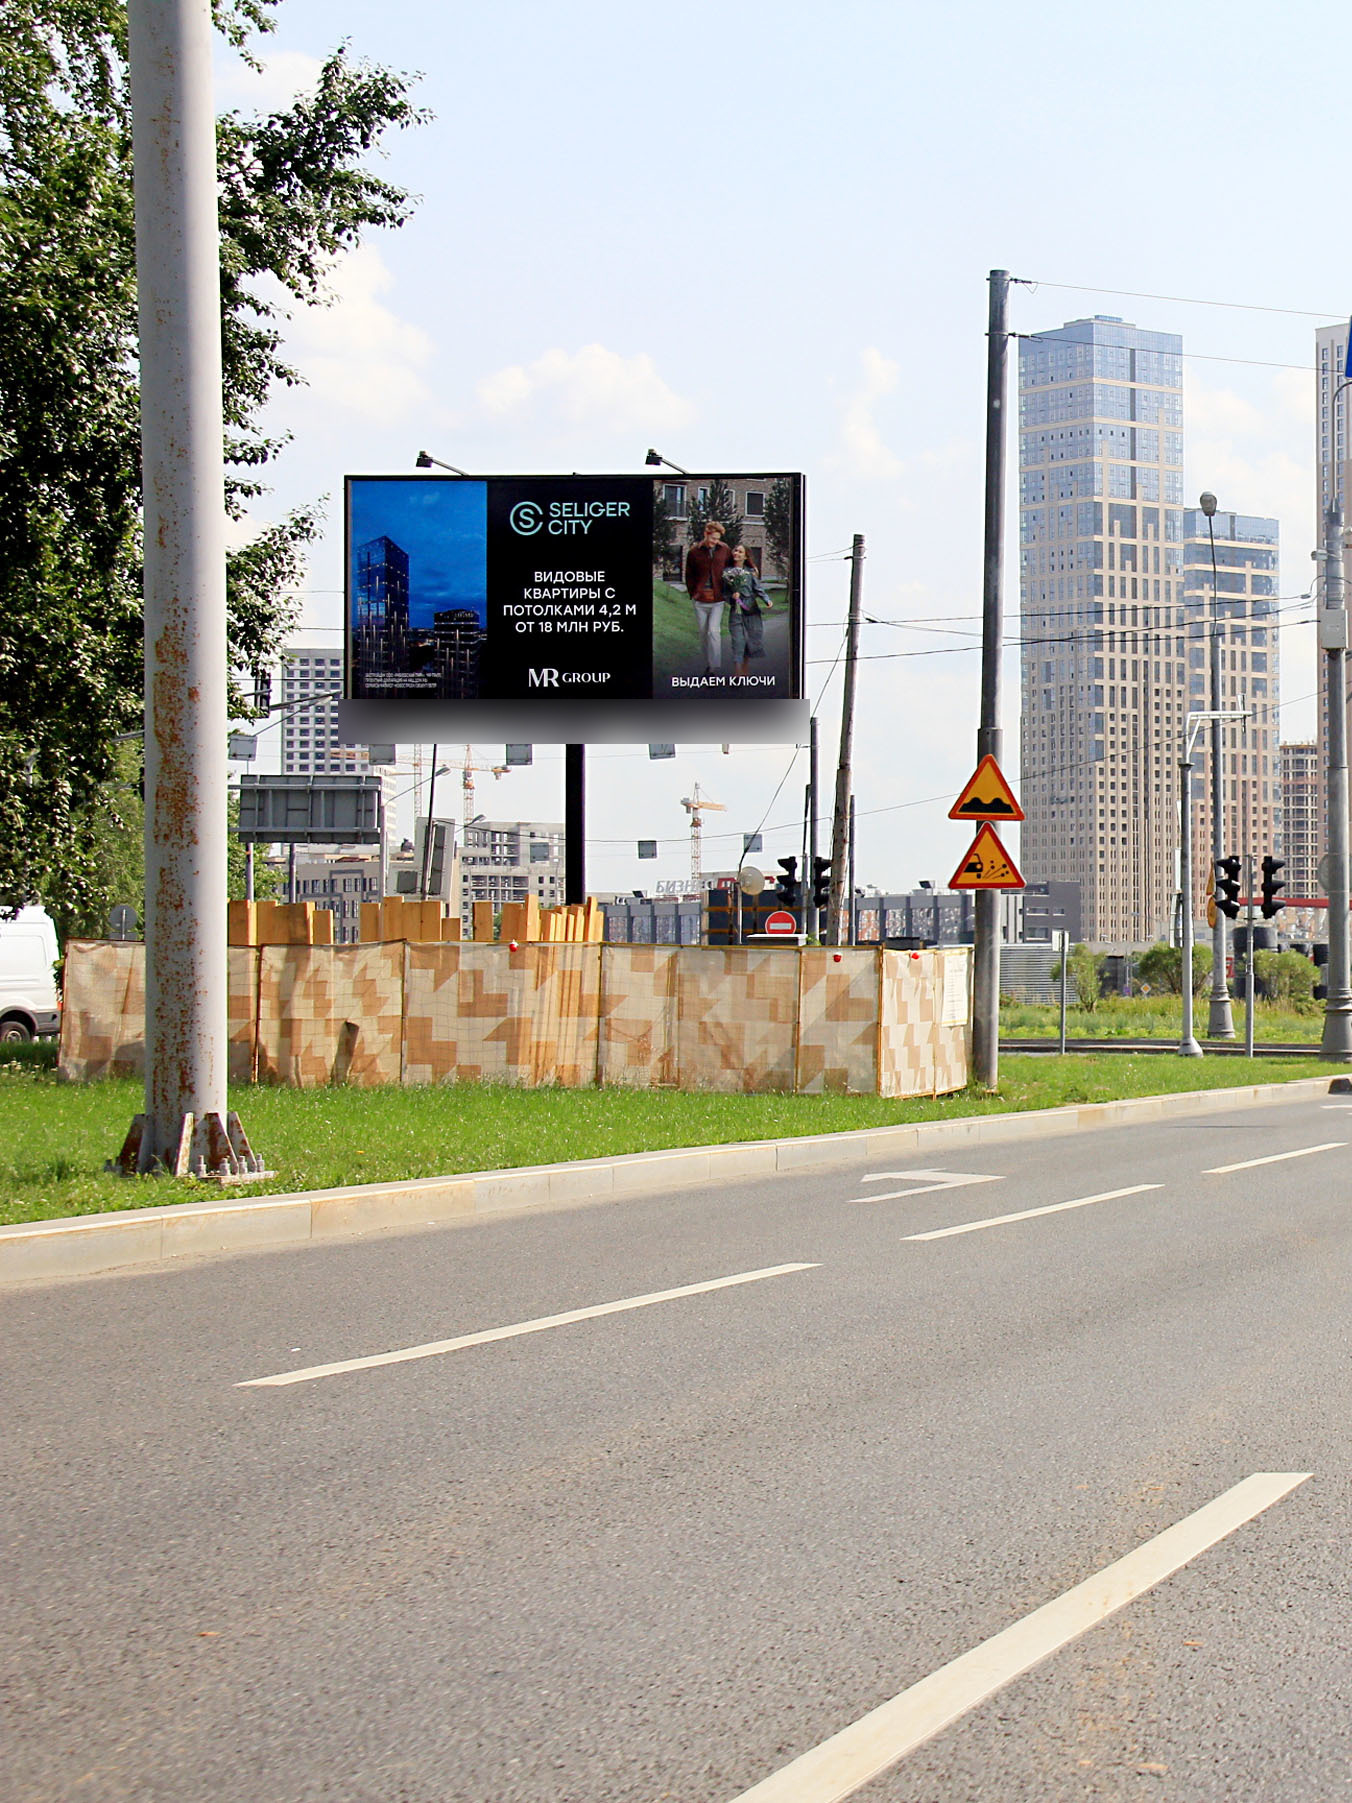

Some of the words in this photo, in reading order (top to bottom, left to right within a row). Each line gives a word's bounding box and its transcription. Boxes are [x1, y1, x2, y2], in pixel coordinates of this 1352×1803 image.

[549, 502, 631, 517] SELIGER
[548, 519, 593, 535] CITY
[534, 571, 606, 584] ВИДОВЫЕ
[524, 588, 601, 600] КВАРТИРЫ
[604, 587, 616, 599] С
[503, 604, 595, 616] ПОТОЛКАМИ
[598, 604, 622, 618] 4,2
[625, 604, 637, 615] М
[515, 621, 535, 633] ОТ
[538, 621, 553, 632] 18
[556, 621, 589, 632] МЛН
[593, 621, 624, 633] РУБ.
[528, 668, 560, 687] MR
[562, 672, 611, 683] GROUP
[671, 676, 726, 689] ВЫДАЕМ
[729, 676, 776, 687] КЛЮЧИ
